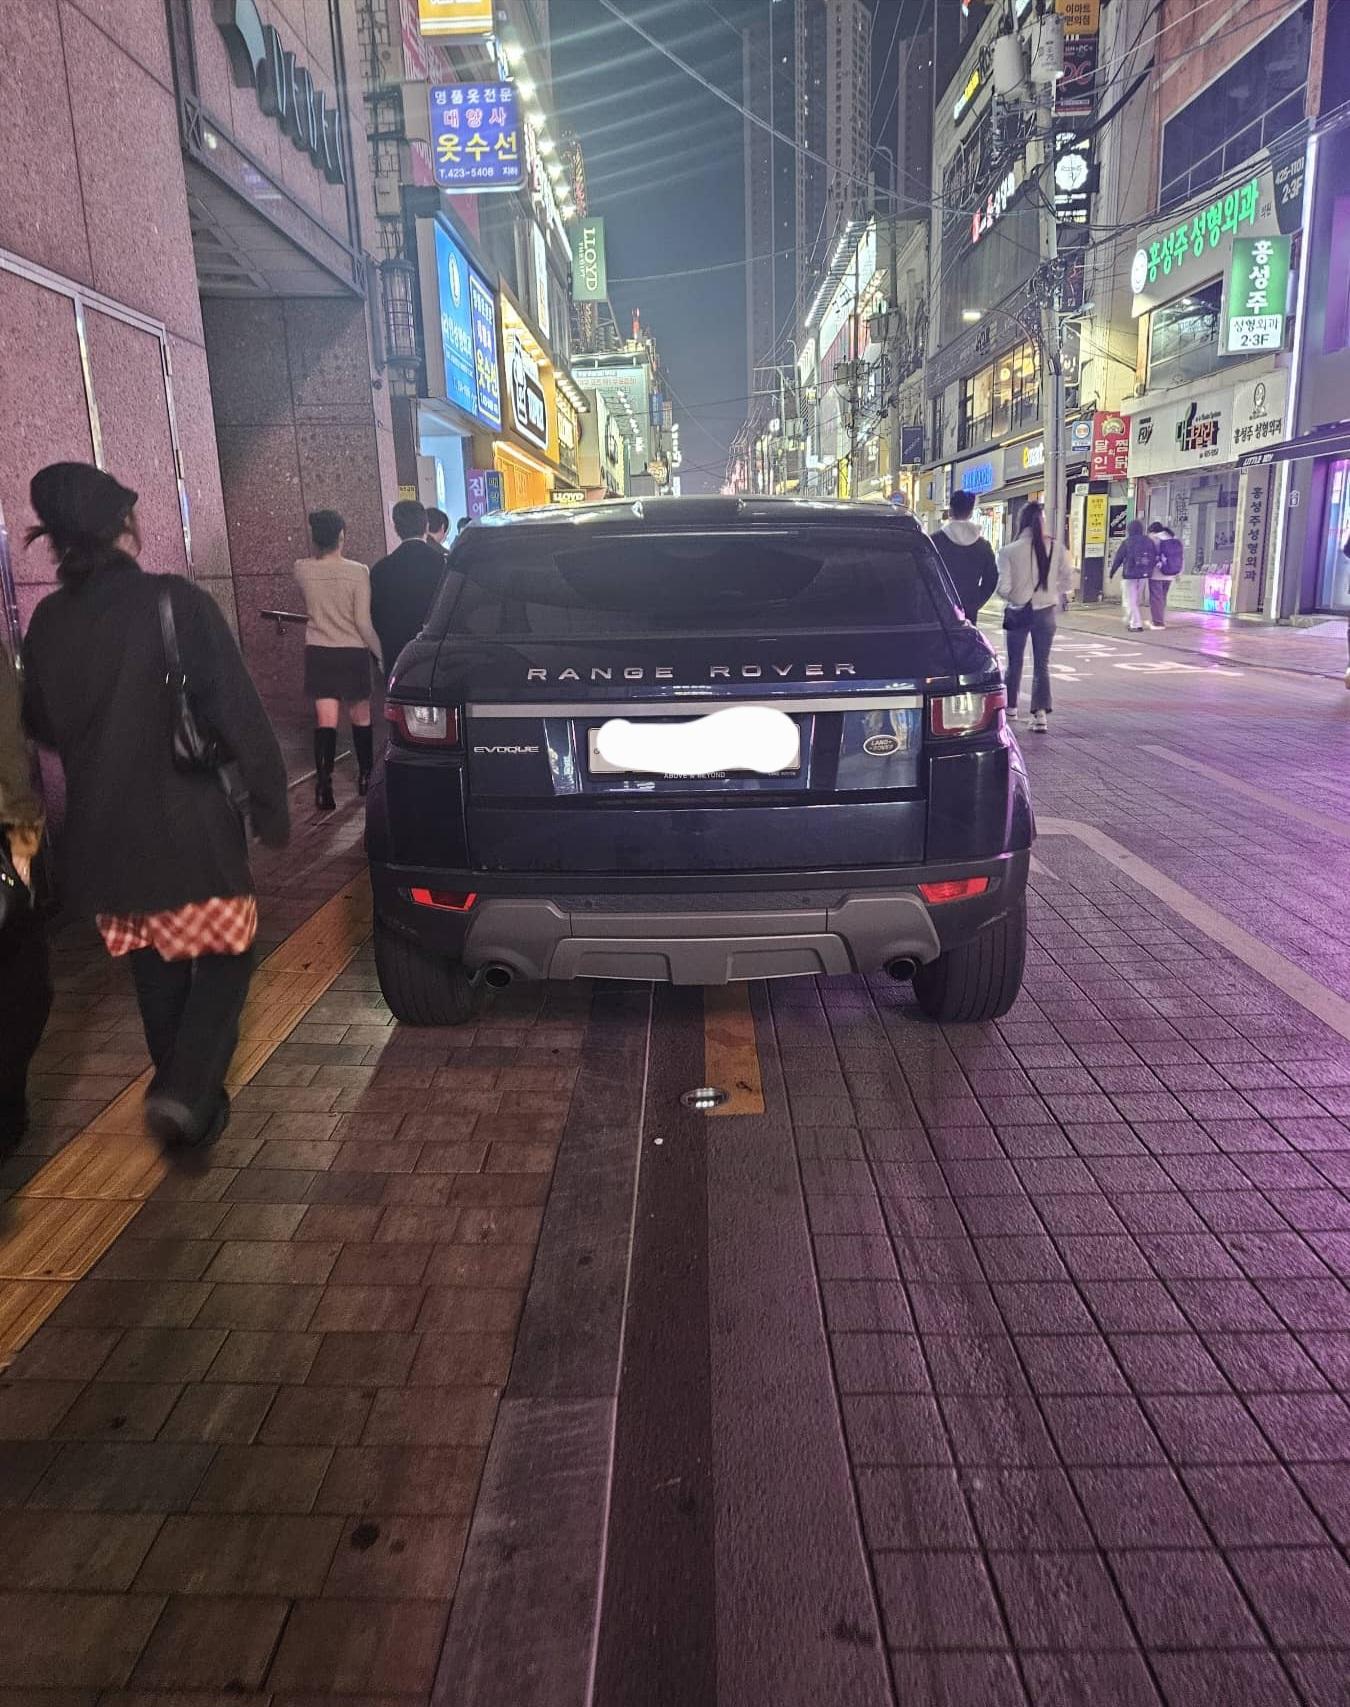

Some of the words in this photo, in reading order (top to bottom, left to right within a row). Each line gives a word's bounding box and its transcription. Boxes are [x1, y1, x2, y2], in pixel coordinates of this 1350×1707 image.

[437, 131, 518, 163] 옷수선
[1148, 224, 1188, 282] 홍성주
[1191, 178, 1259, 257] 성형외과
[1245, 240, 1274, 315] 홍성주
[1234, 317, 1278, 333] 성형외과
[1234, 425, 1253, 444] 홍성주
[1255, 417, 1282, 439] 성형외과
[527, 667, 673, 681] RANGE
[709, 662, 857, 678] ROVER
[473, 746, 540, 754] EVOQUE
